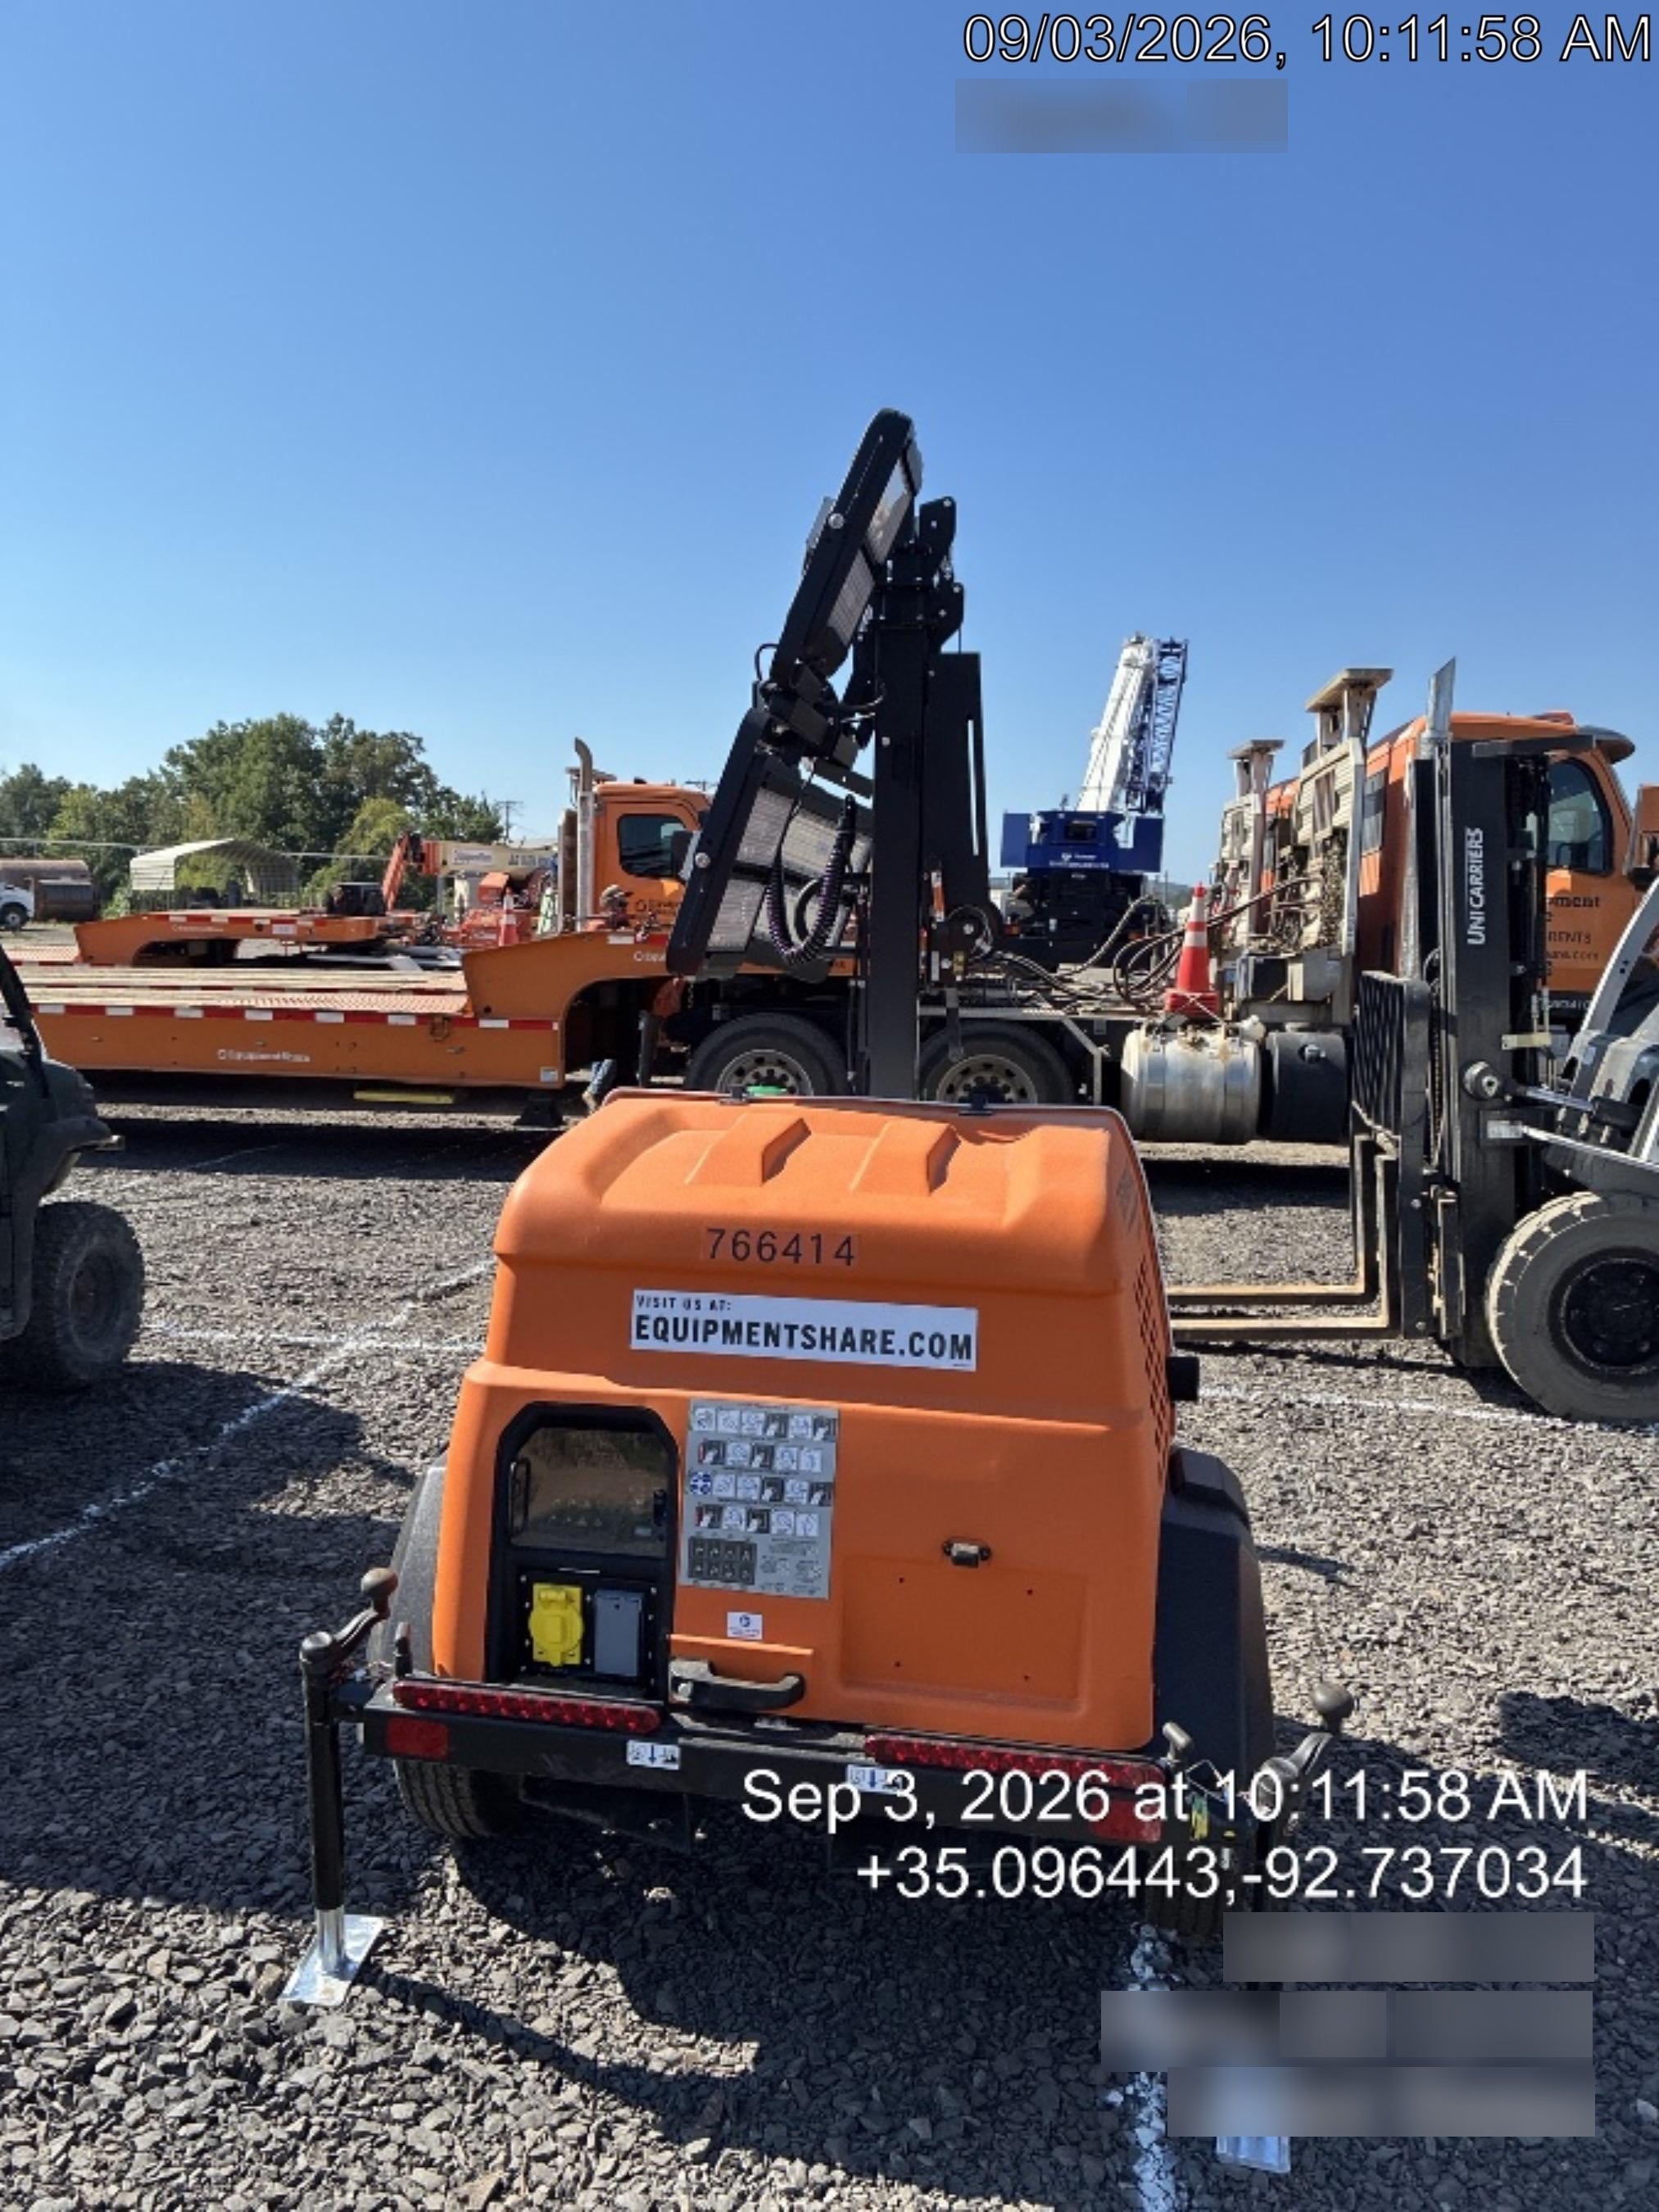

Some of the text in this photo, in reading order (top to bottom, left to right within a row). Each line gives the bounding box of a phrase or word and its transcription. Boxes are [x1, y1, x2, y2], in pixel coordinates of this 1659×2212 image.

[1467, 827, 1485, 945] UNICARRIERS
[706, 1228, 854, 1267] 766414
[637, 1295, 732, 1311] VISIT US AT:
[636, 1314, 972, 1361] EQUIPMENTSHARE.COM
